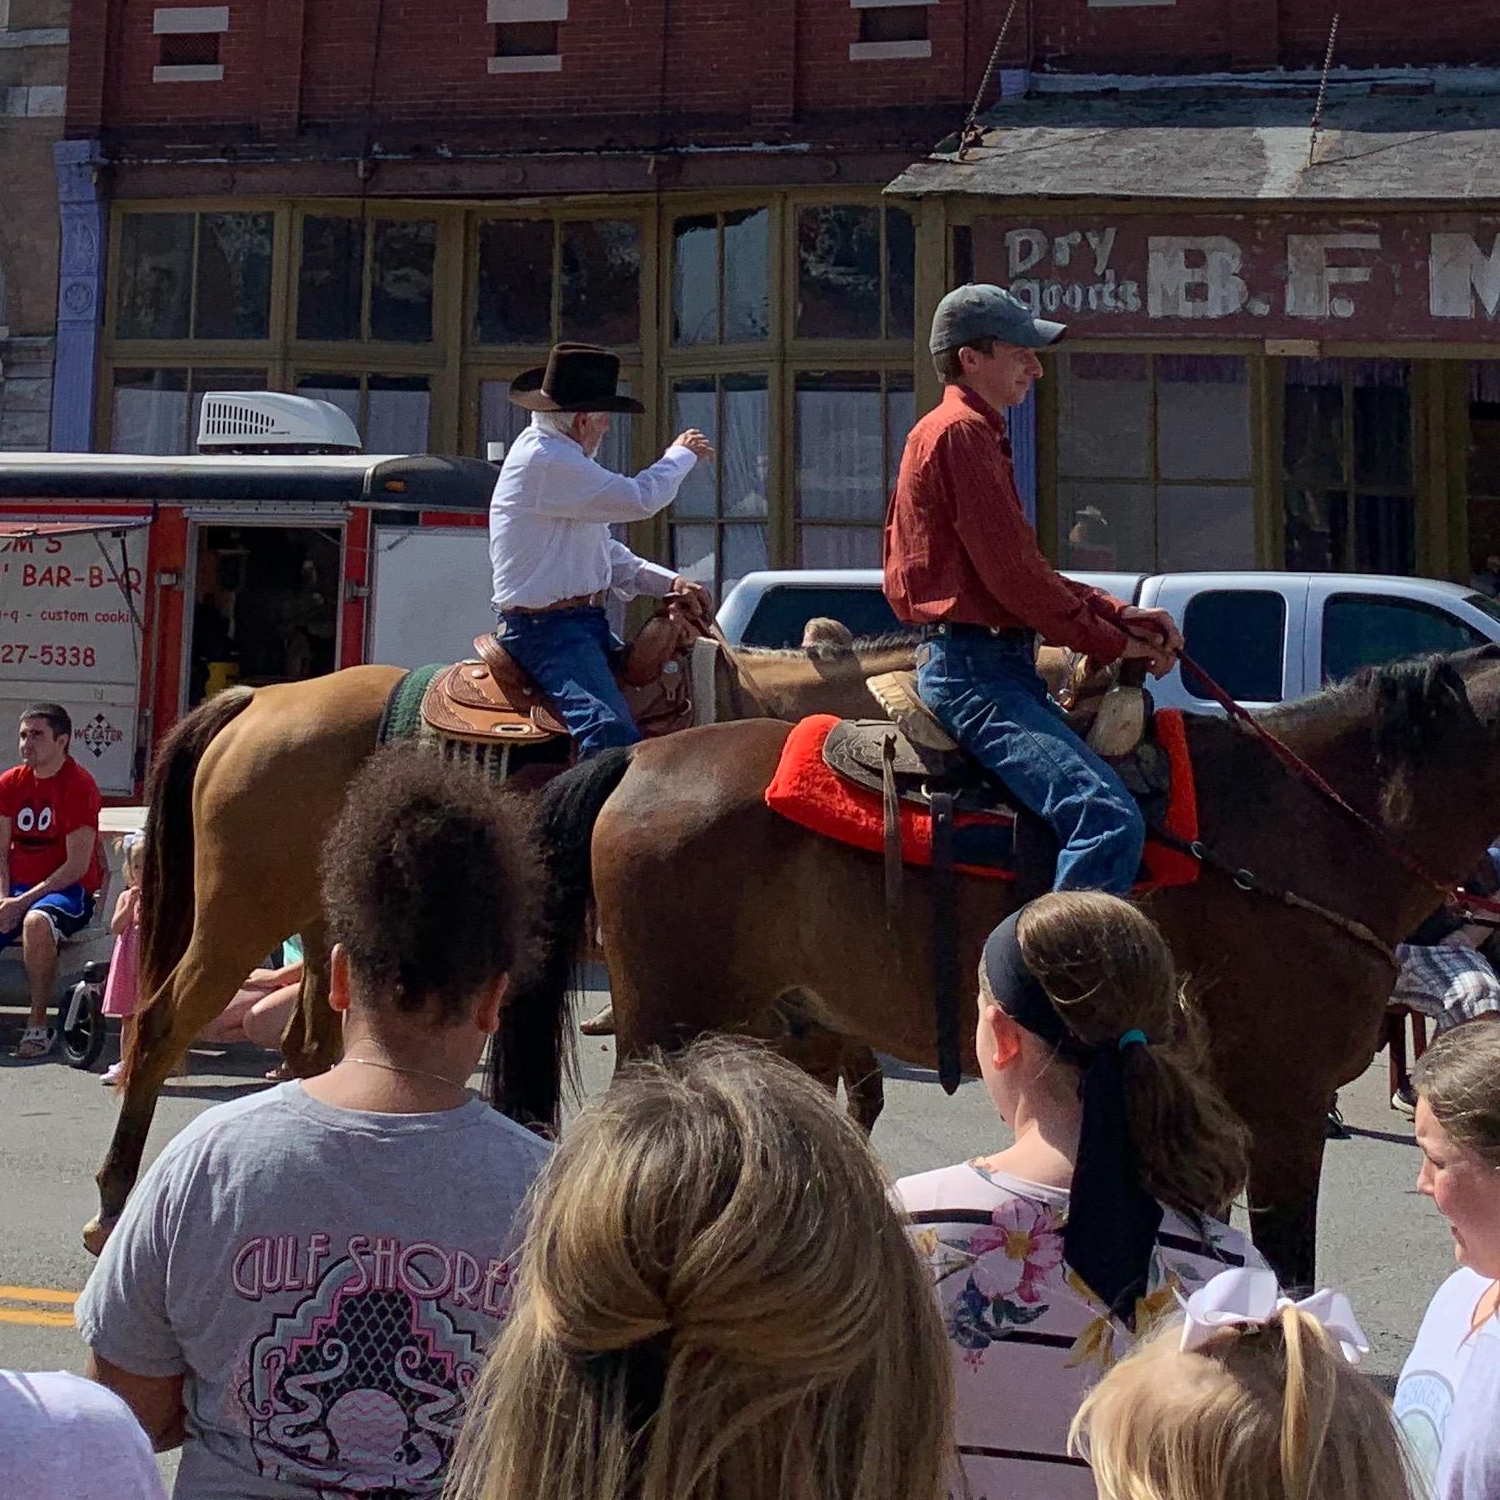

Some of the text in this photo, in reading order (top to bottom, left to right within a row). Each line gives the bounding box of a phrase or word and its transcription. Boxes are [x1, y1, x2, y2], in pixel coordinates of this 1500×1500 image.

[1004, 227, 1117, 278] Dry
[22, 563, 142, 595] BAR-B-Q
[40, 610, 88, 622] custom
[232, 1233, 524, 1322] GULF SHORE
